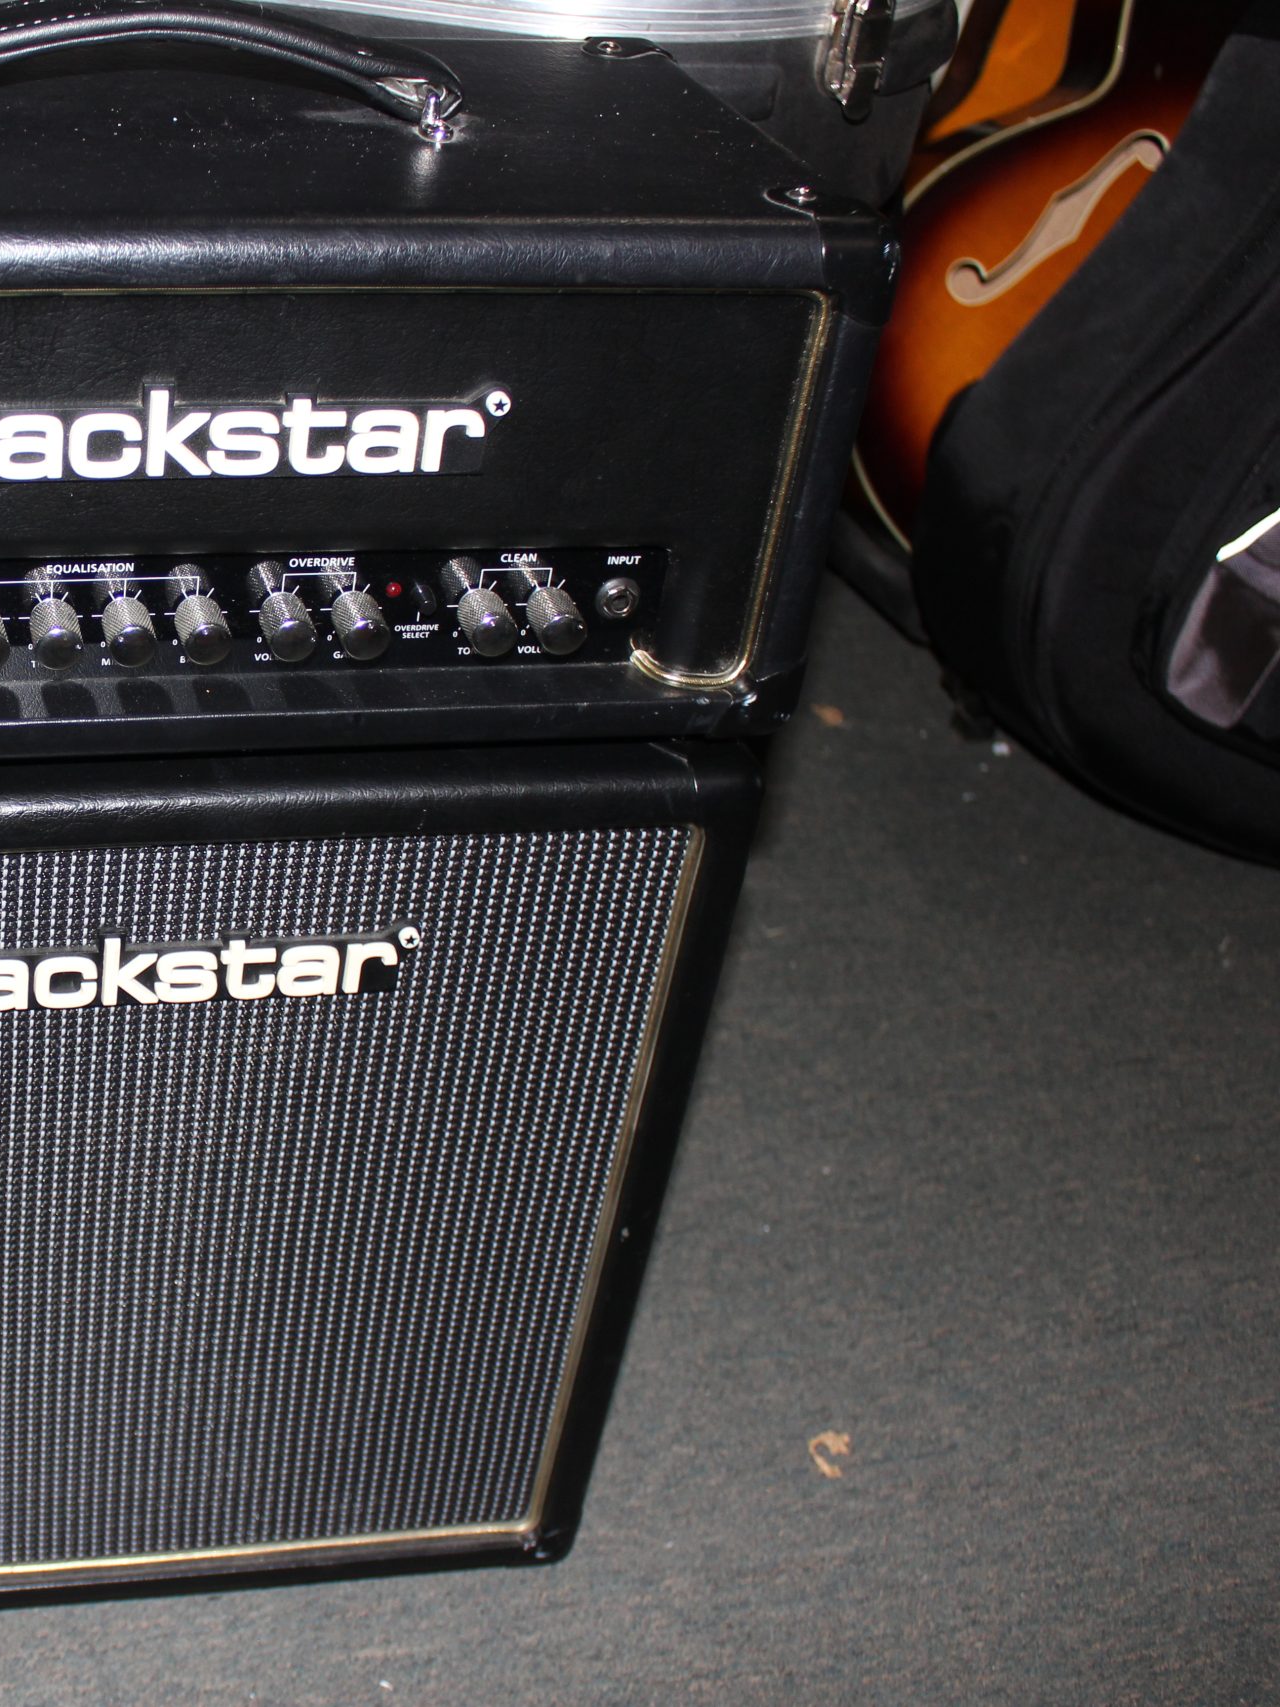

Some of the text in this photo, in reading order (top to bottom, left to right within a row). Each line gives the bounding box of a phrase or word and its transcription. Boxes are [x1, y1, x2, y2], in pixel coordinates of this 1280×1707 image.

[288, 556, 356, 568] OVERDRIVE
[500, 553, 537, 563] CLEAN
[607, 555, 642, 565] INPUT
[46, 562, 135, 575] EQUALISATION
[394, 624, 439, 632] OVERDRIVE
[402, 631, 430, 639] SELECT
